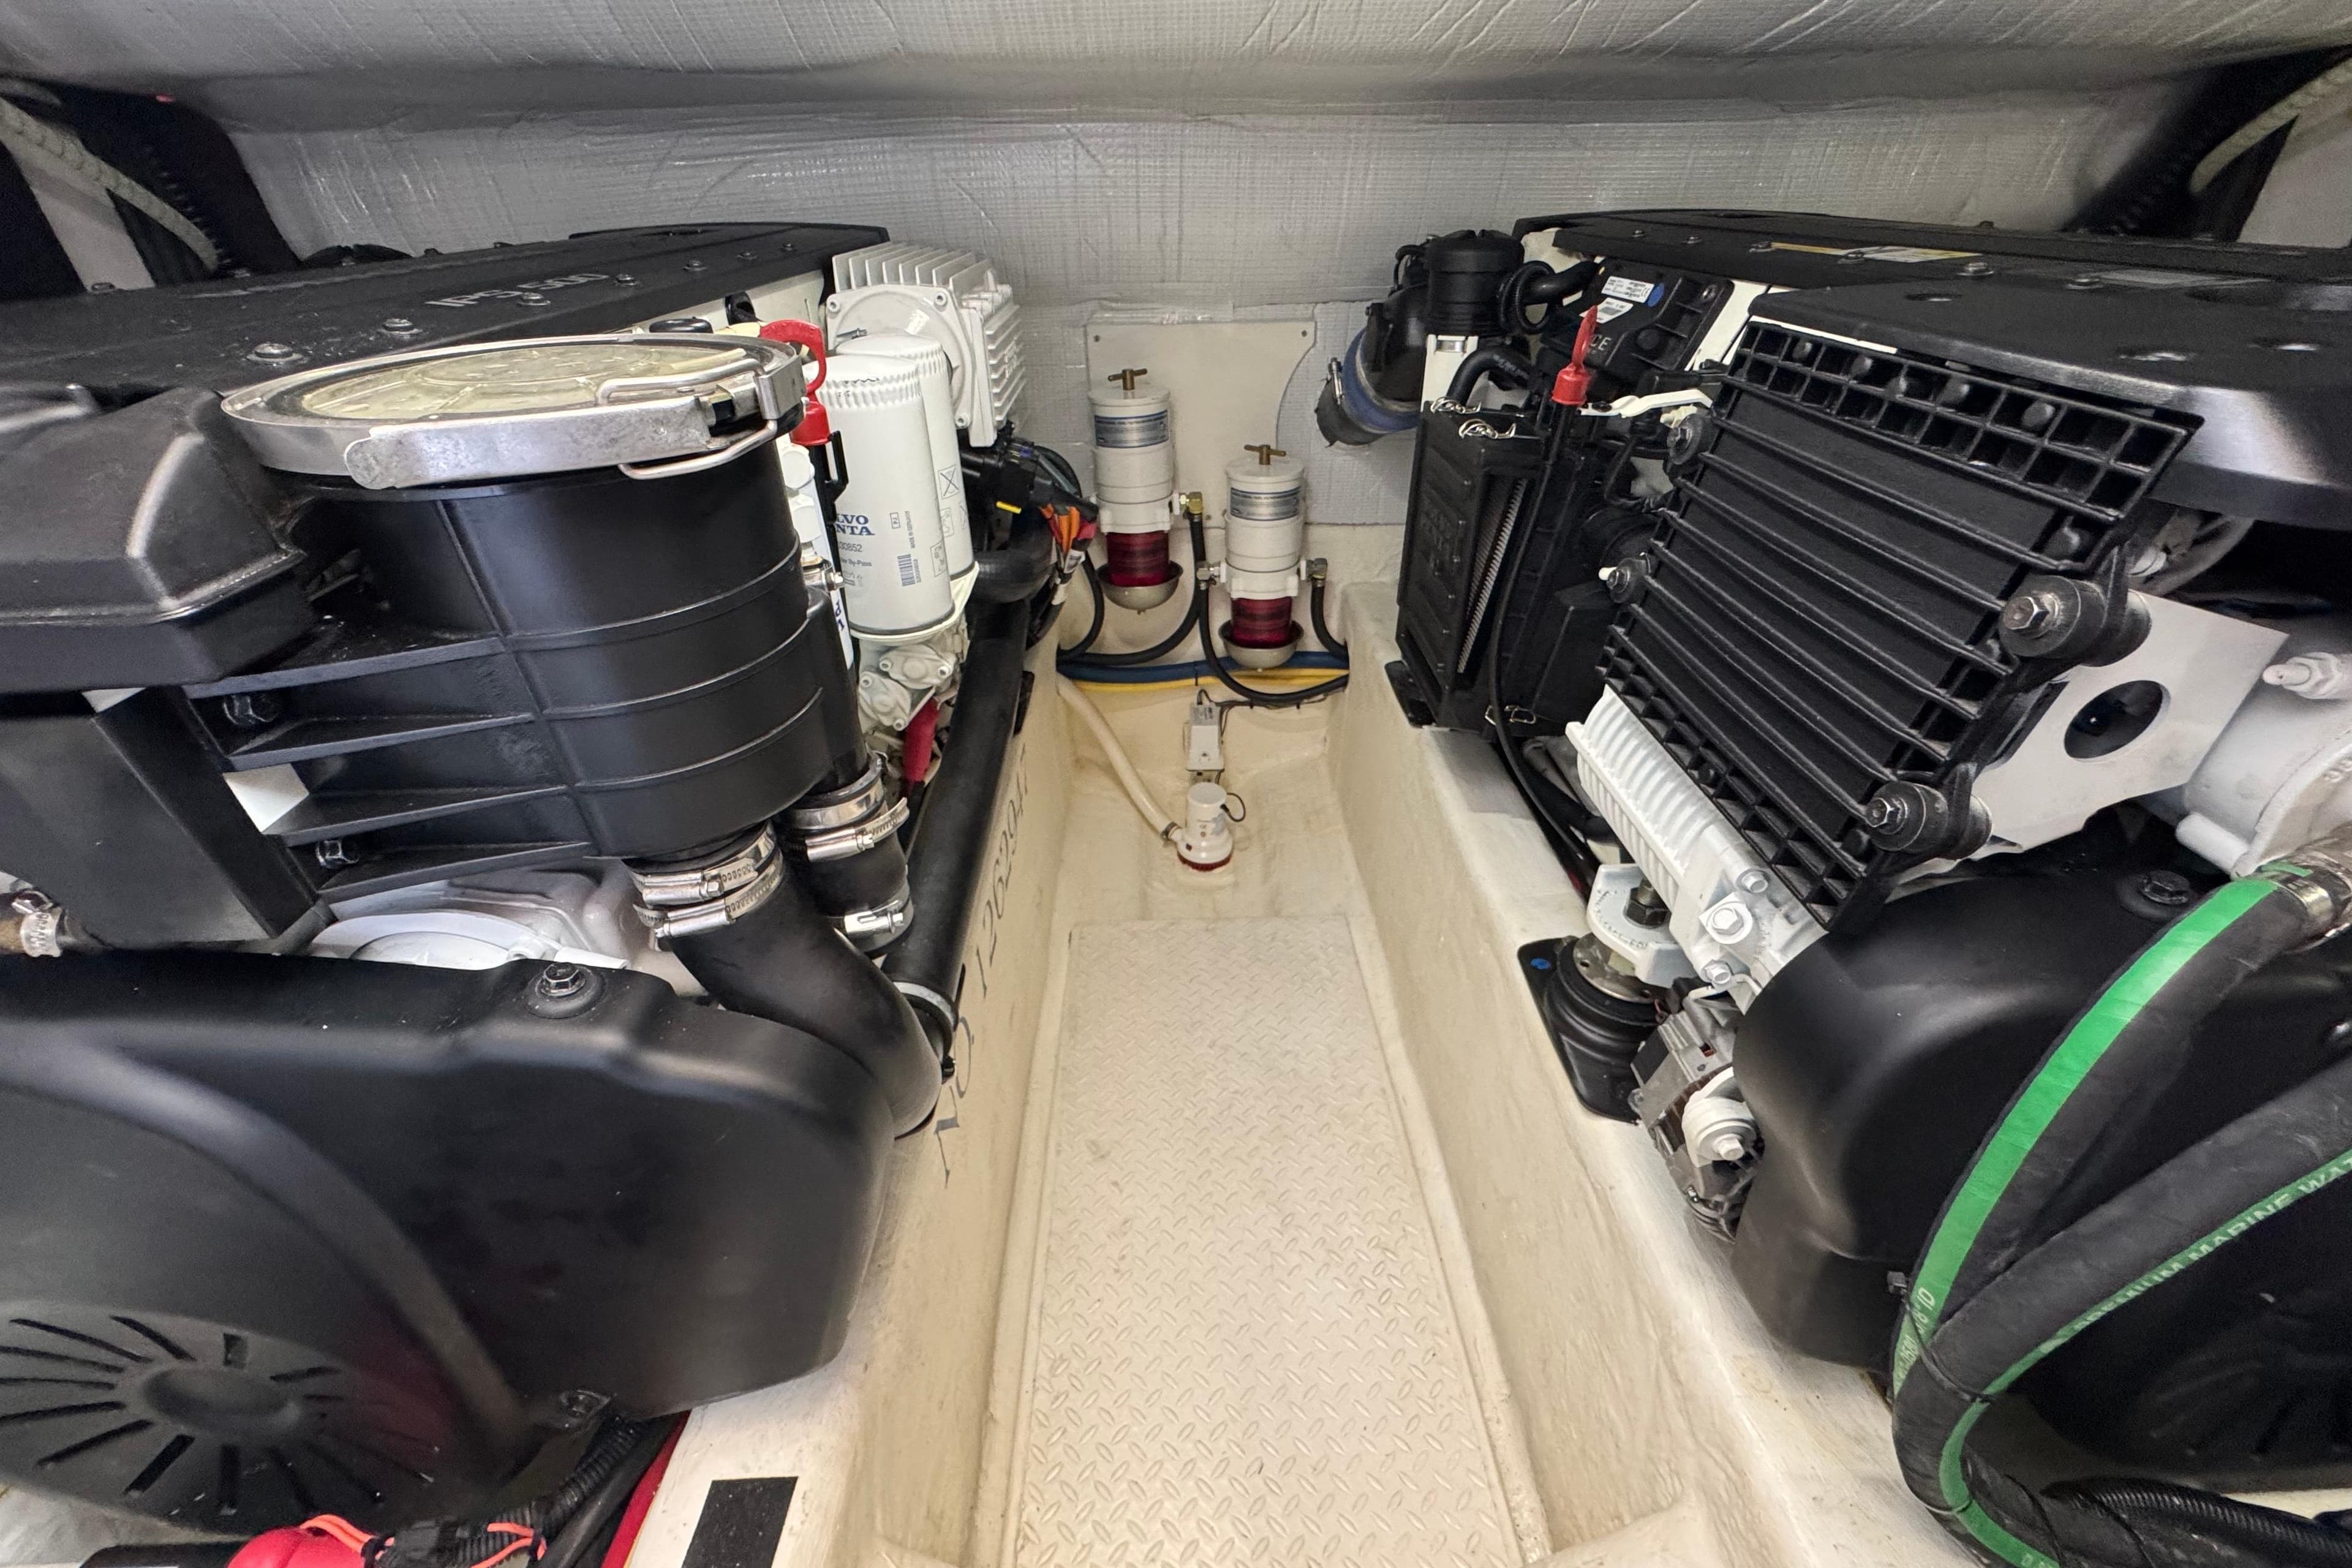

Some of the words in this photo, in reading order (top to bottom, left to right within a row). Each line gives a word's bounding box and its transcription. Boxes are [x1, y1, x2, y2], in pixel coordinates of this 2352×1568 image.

[517, 273, 609, 290] 500
[837, 513, 869, 525] LVO
[835, 523, 875, 536] NTA
